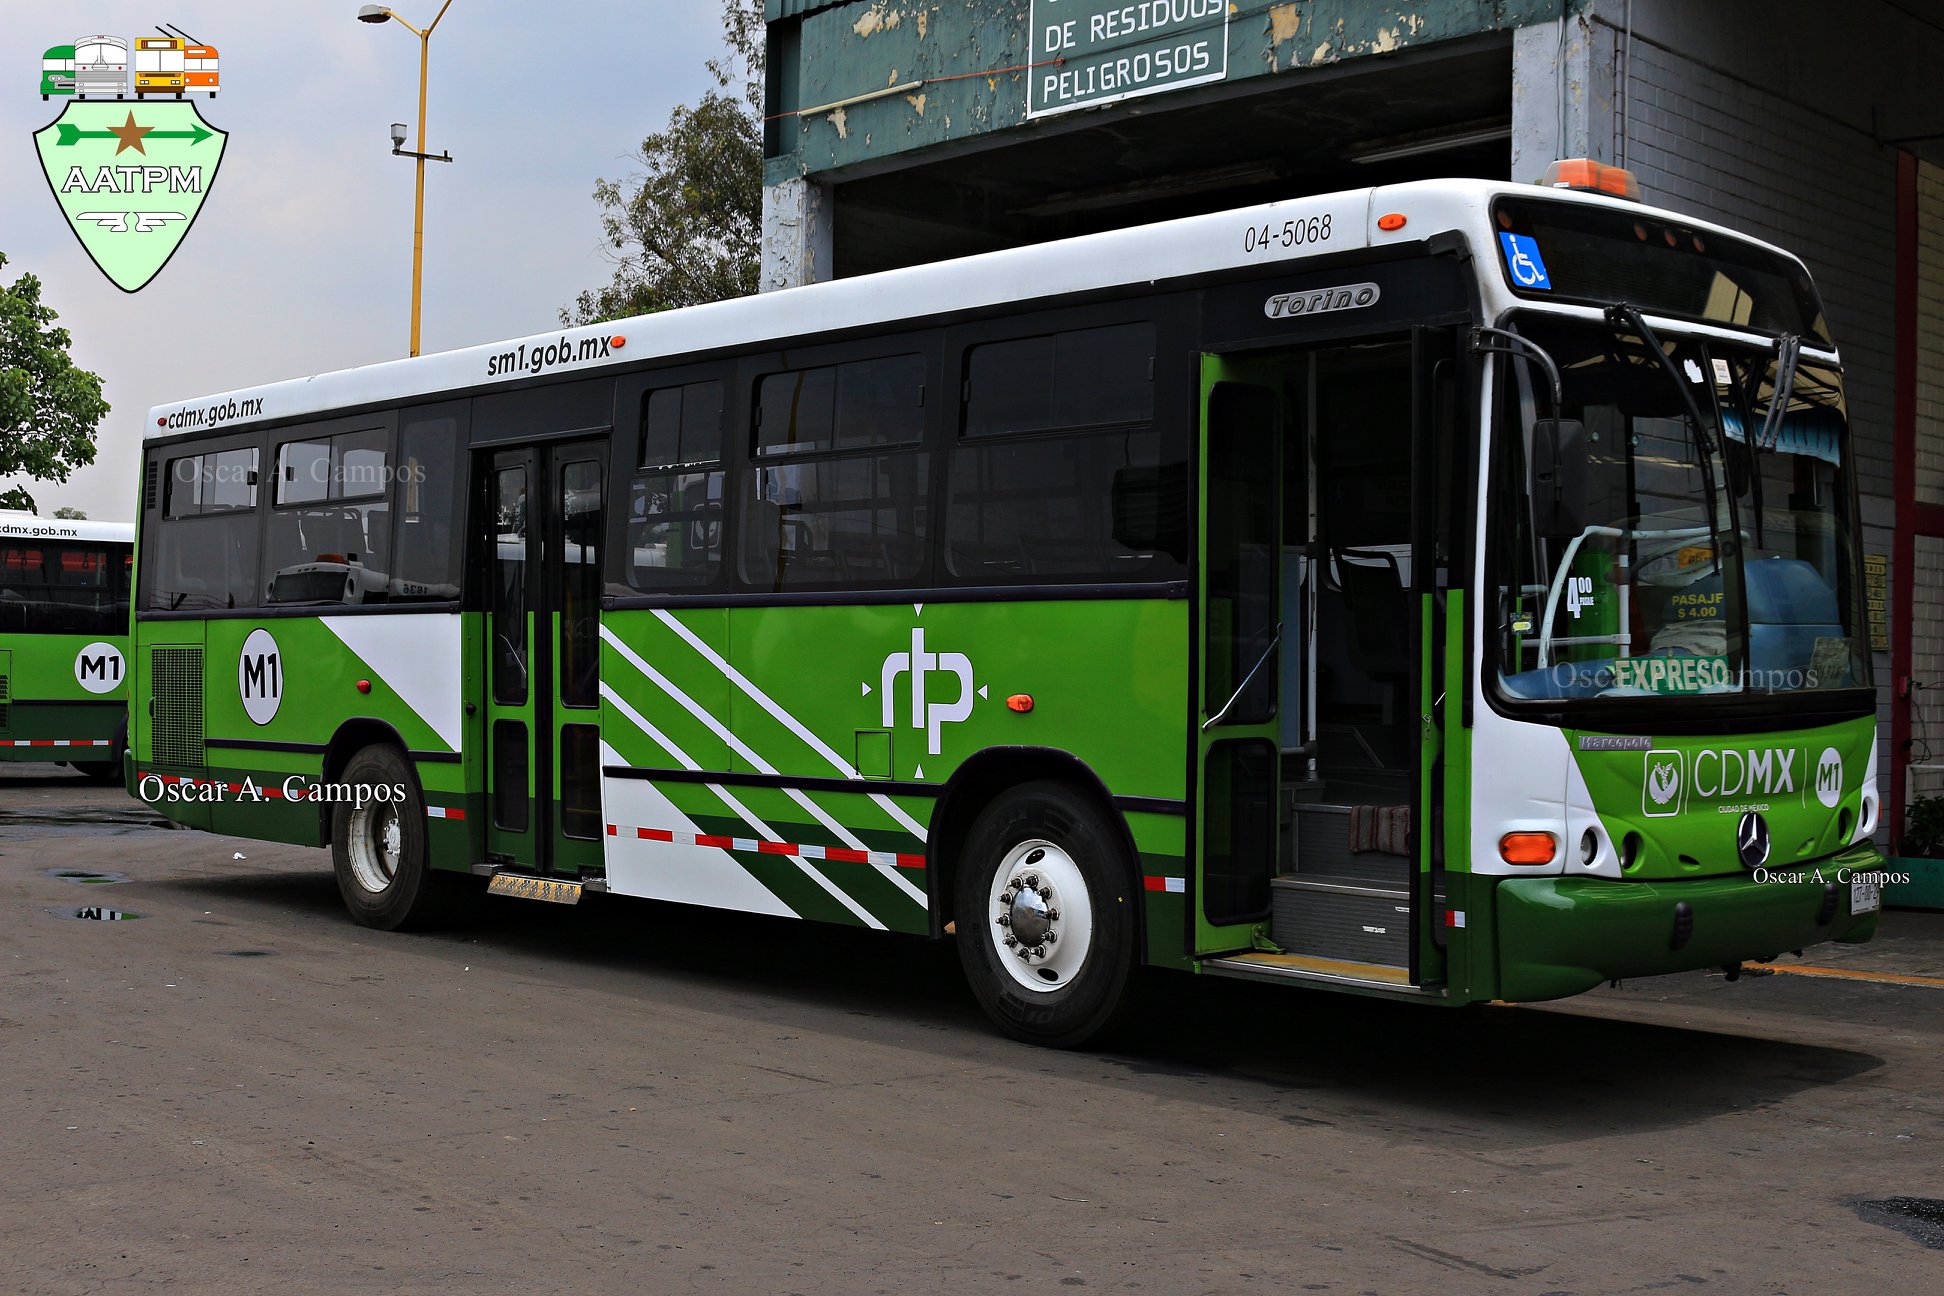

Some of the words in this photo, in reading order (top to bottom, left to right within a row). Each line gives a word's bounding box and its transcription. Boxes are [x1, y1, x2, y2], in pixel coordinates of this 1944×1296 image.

[1045, 20, 1076, 53] DE
[1090, 0, 1223, 43] RESIDUOS
[1043, 41, 1210, 103] PELIGROSOS
[1244, 213, 1332, 253] 04-5068
[1271, 287, 1374, 317] Torino
[487, 335, 611, 376] sm1.gob.mx
[167, 396, 264, 429] cdmx.gob.mx
[0, 524, 78, 537] dmx.gob.mx
[1688, 606, 1717, 617] 4.00
[80, 655, 120, 681] M1
[243, 652, 279, 699] M1
[1615, 658, 1729, 692] EXPRESO
[1694, 748, 1797, 797] CDMX
[1819, 760, 1841, 793] M1
